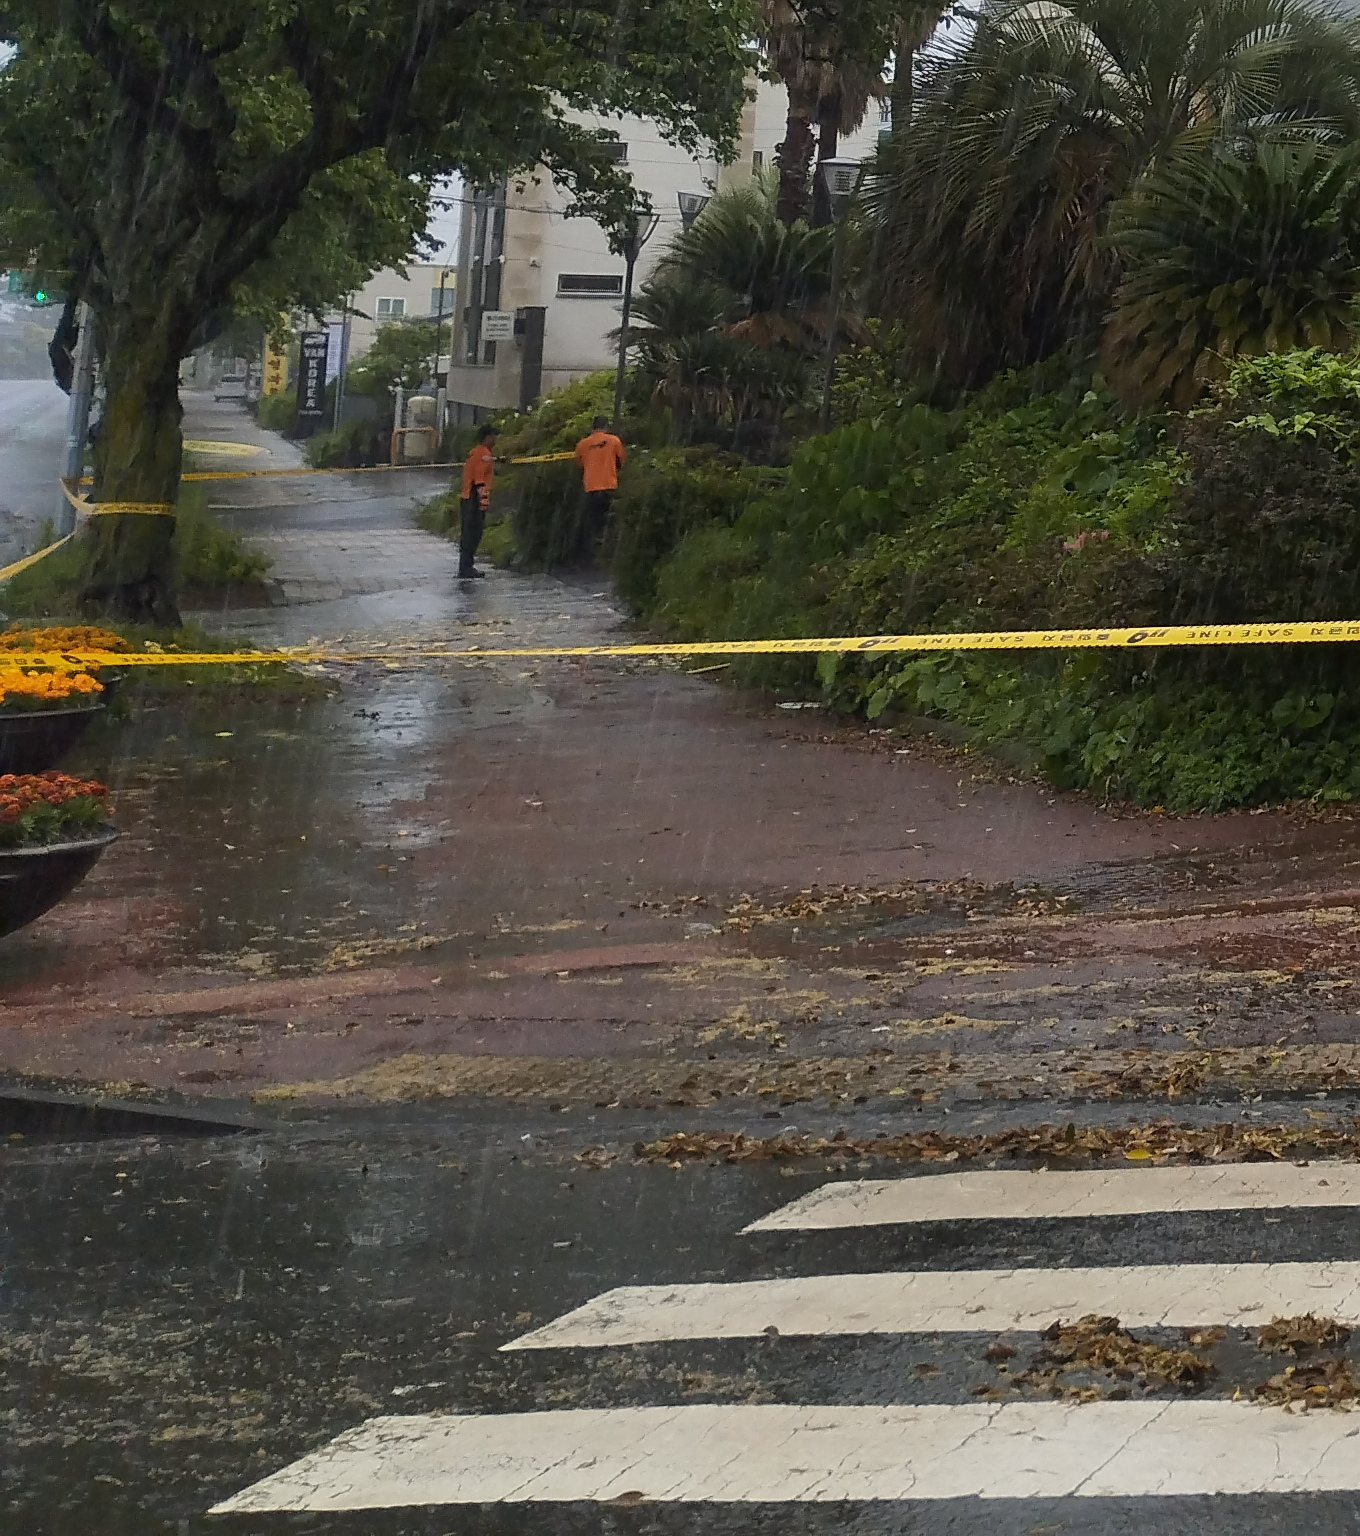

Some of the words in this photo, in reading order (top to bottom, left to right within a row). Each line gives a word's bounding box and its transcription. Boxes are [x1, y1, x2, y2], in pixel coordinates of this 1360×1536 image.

[303, 348, 325, 357] VAN
[305, 359, 318, 408] KOREA
[1185, 630, 1232, 638] LINE
[1241, 628, 1294, 637] SAFE
[976, 635, 1025, 643] SAFE
